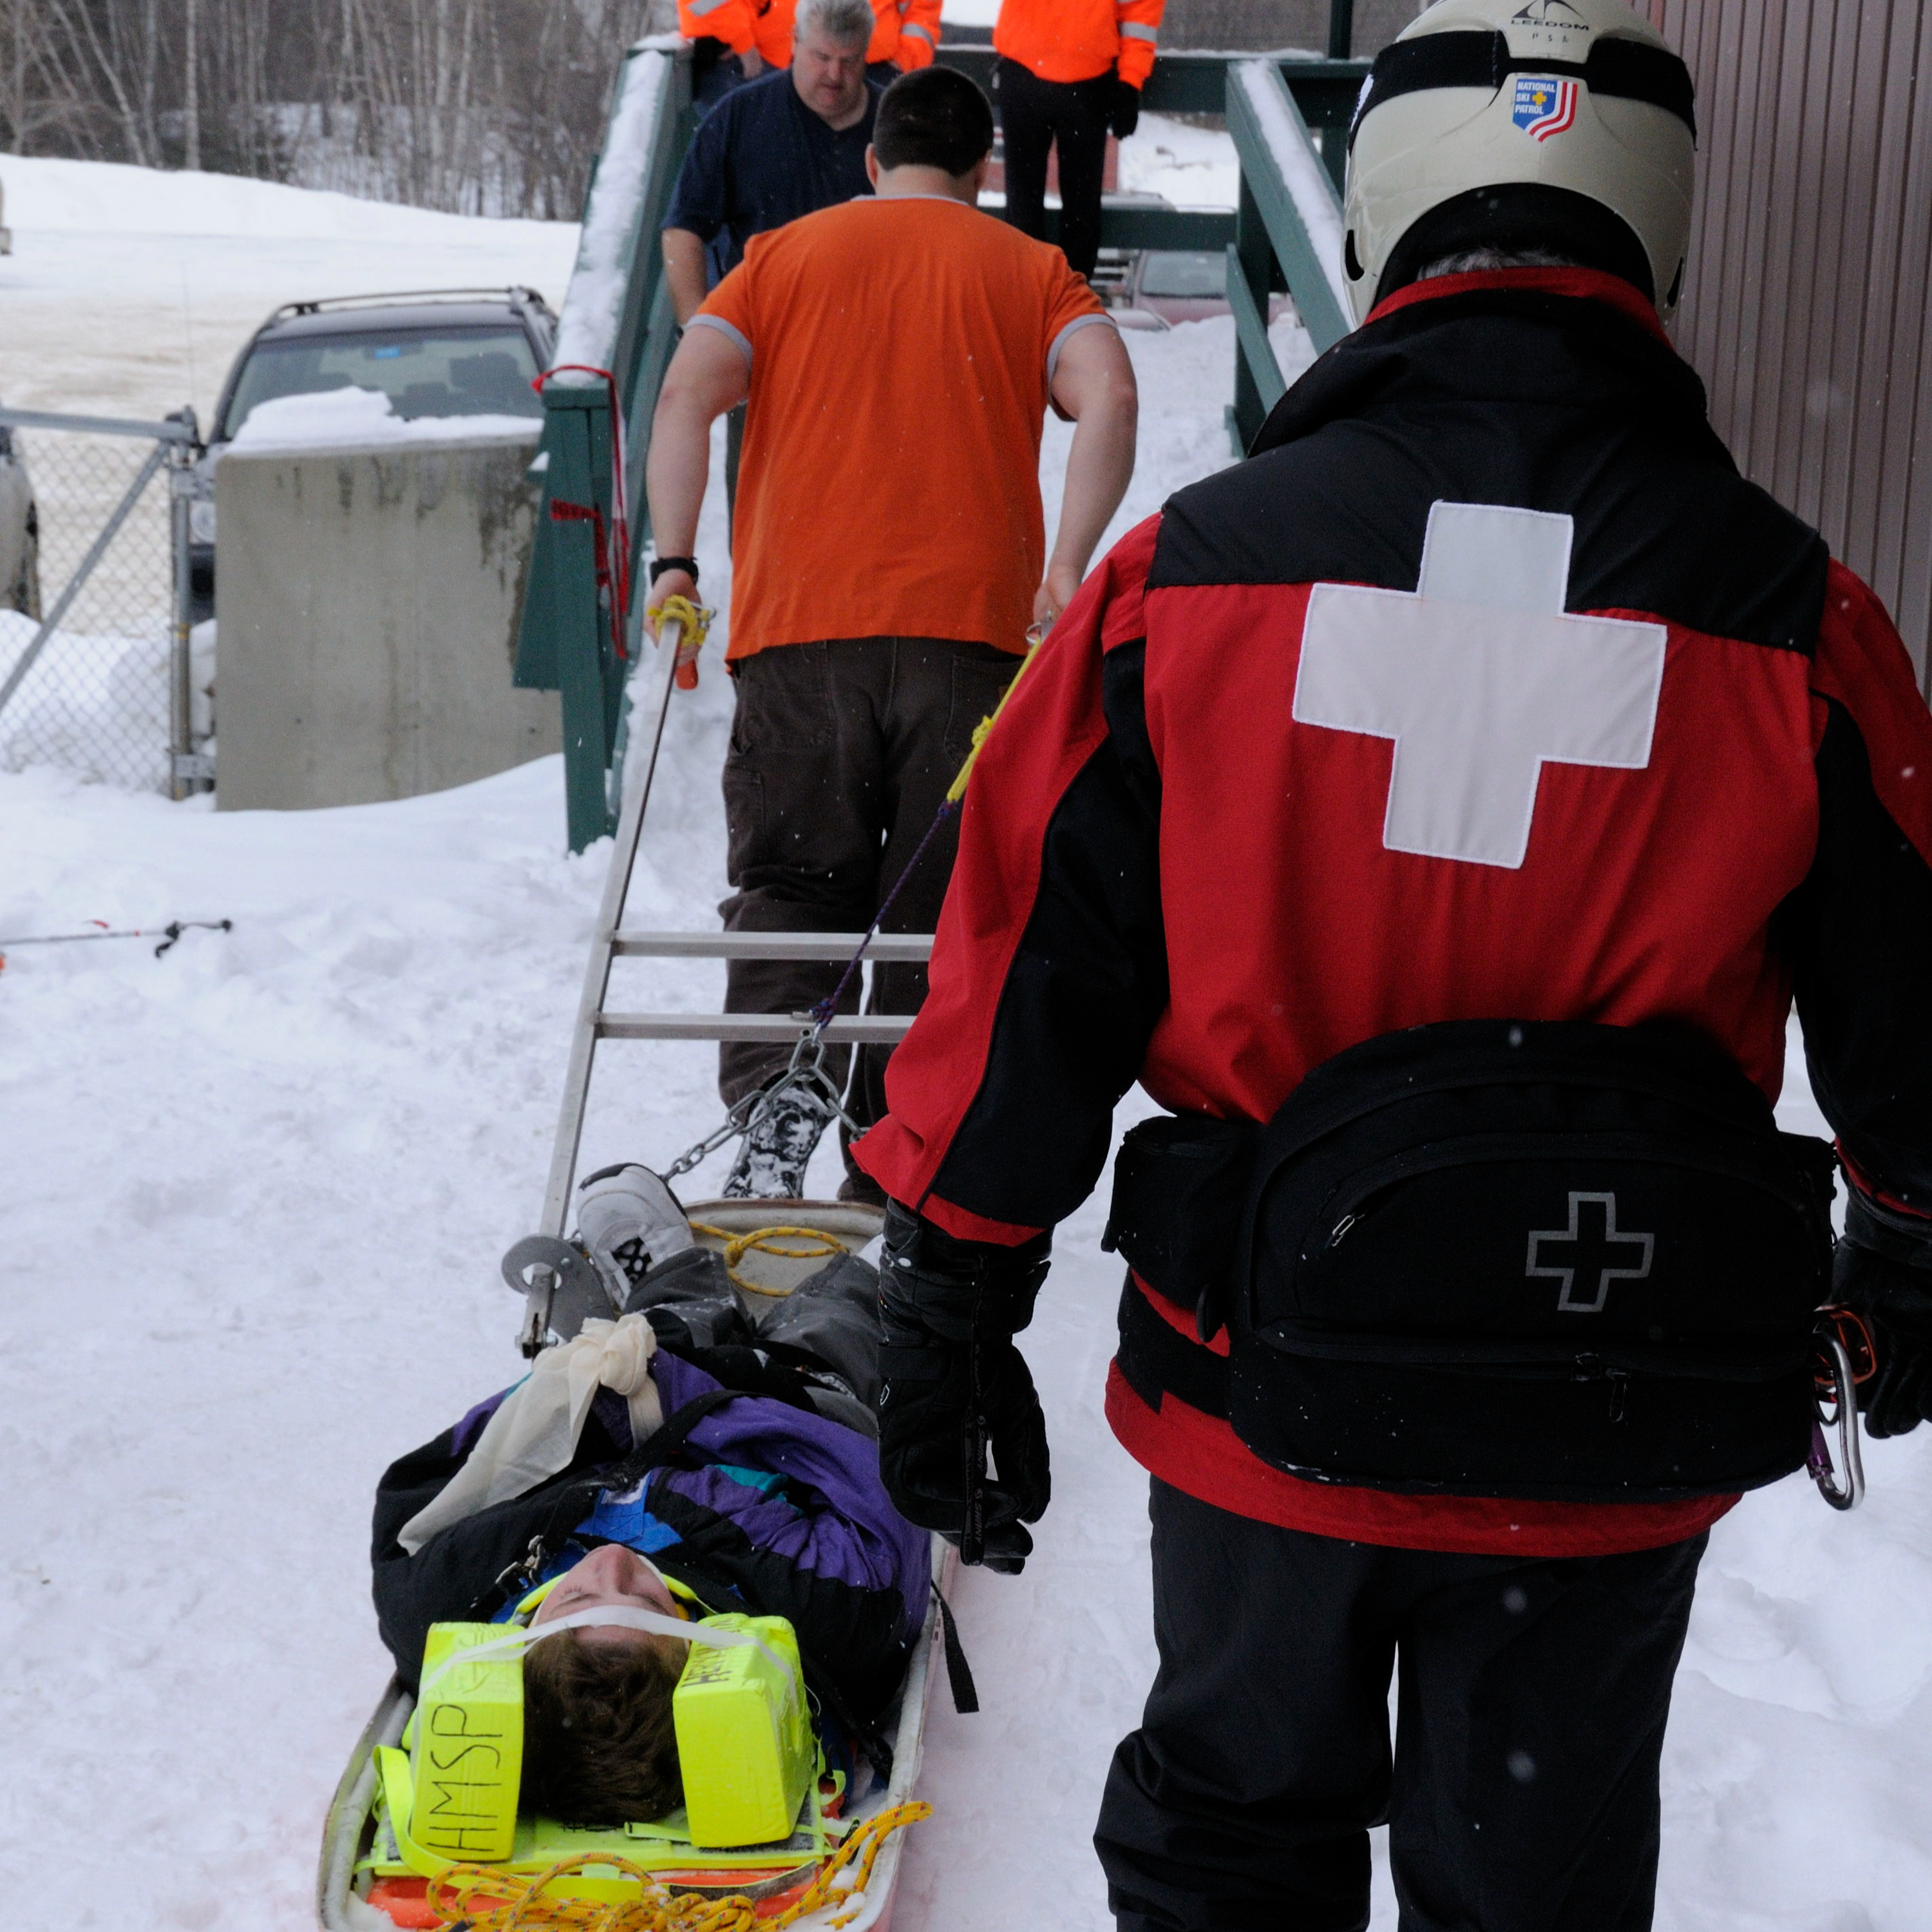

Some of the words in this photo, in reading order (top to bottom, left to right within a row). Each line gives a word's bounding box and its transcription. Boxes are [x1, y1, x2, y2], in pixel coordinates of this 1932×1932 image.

[1511, 19, 1589, 30] LEEDOM
[1517, 81, 1556, 93] NATIONAL
[1516, 93, 1530, 102] SKI
[1515, 104, 1544, 115] PATROL
[426, 1703, 504, 1852] HMSP
